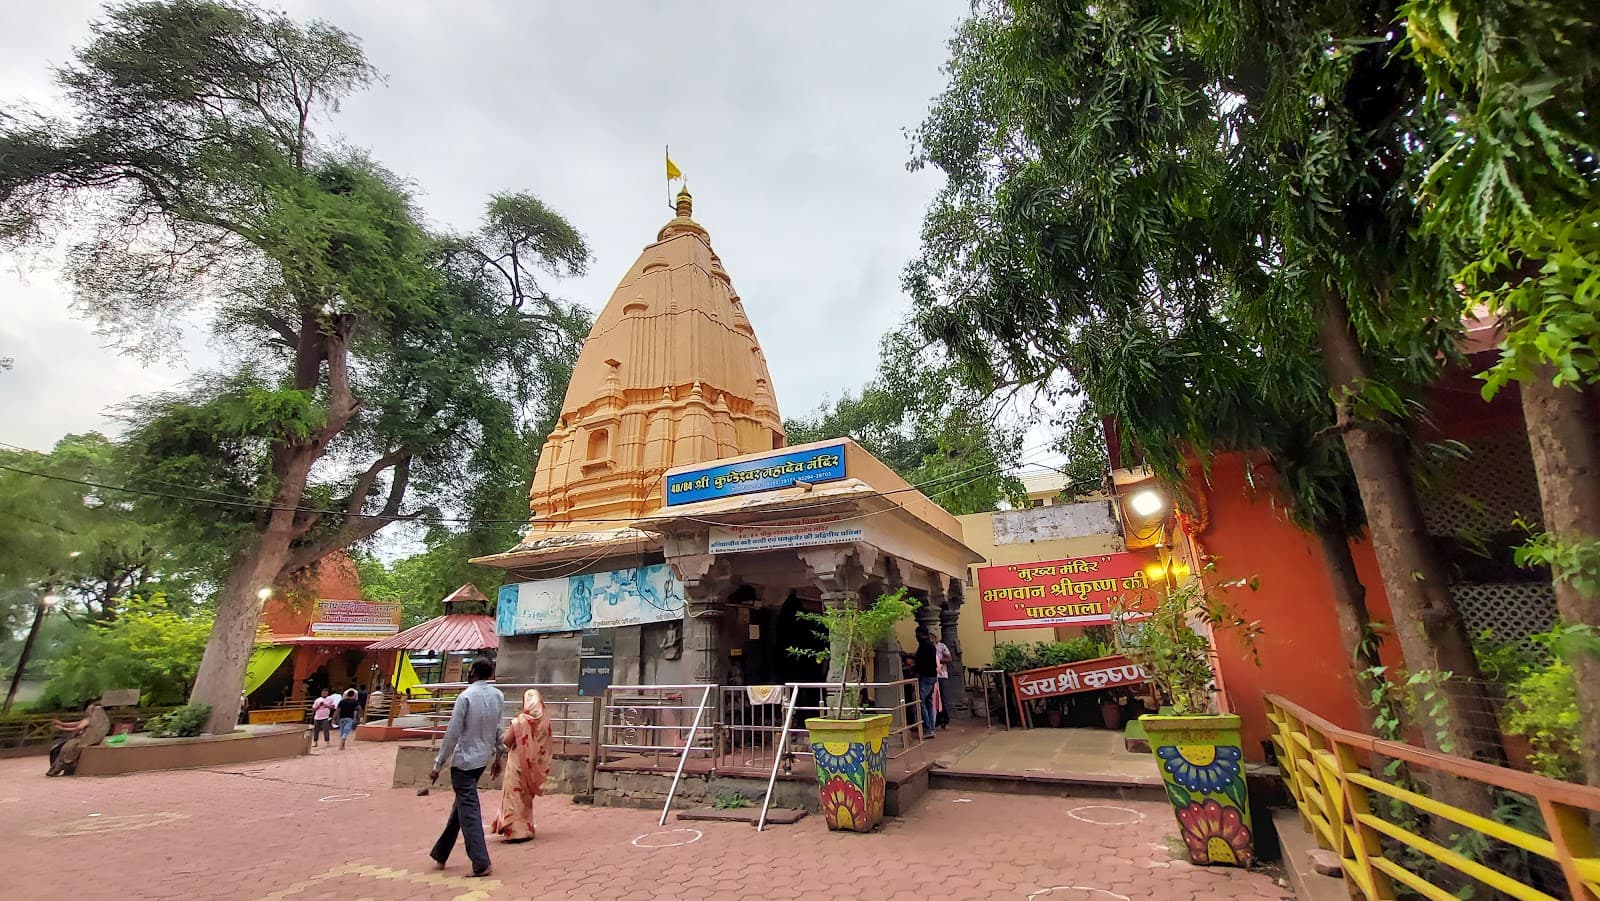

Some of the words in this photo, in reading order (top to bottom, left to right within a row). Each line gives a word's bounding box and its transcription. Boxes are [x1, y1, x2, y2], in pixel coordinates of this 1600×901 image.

[671, 481, 693, 494] 40/84
[694, 475, 710, 489] श्री
[762, 460, 803, 478] महादेव
[806, 454, 839, 469] मंदिर
[983, 584, 1046, 603] भगवान
[1050, 577, 1117, 600] श्रीकृष्ण
[1121, 570, 1149, 589] की
[1019, 677, 1057, 696] जय
[1057, 668, 1080, 692] श्री
